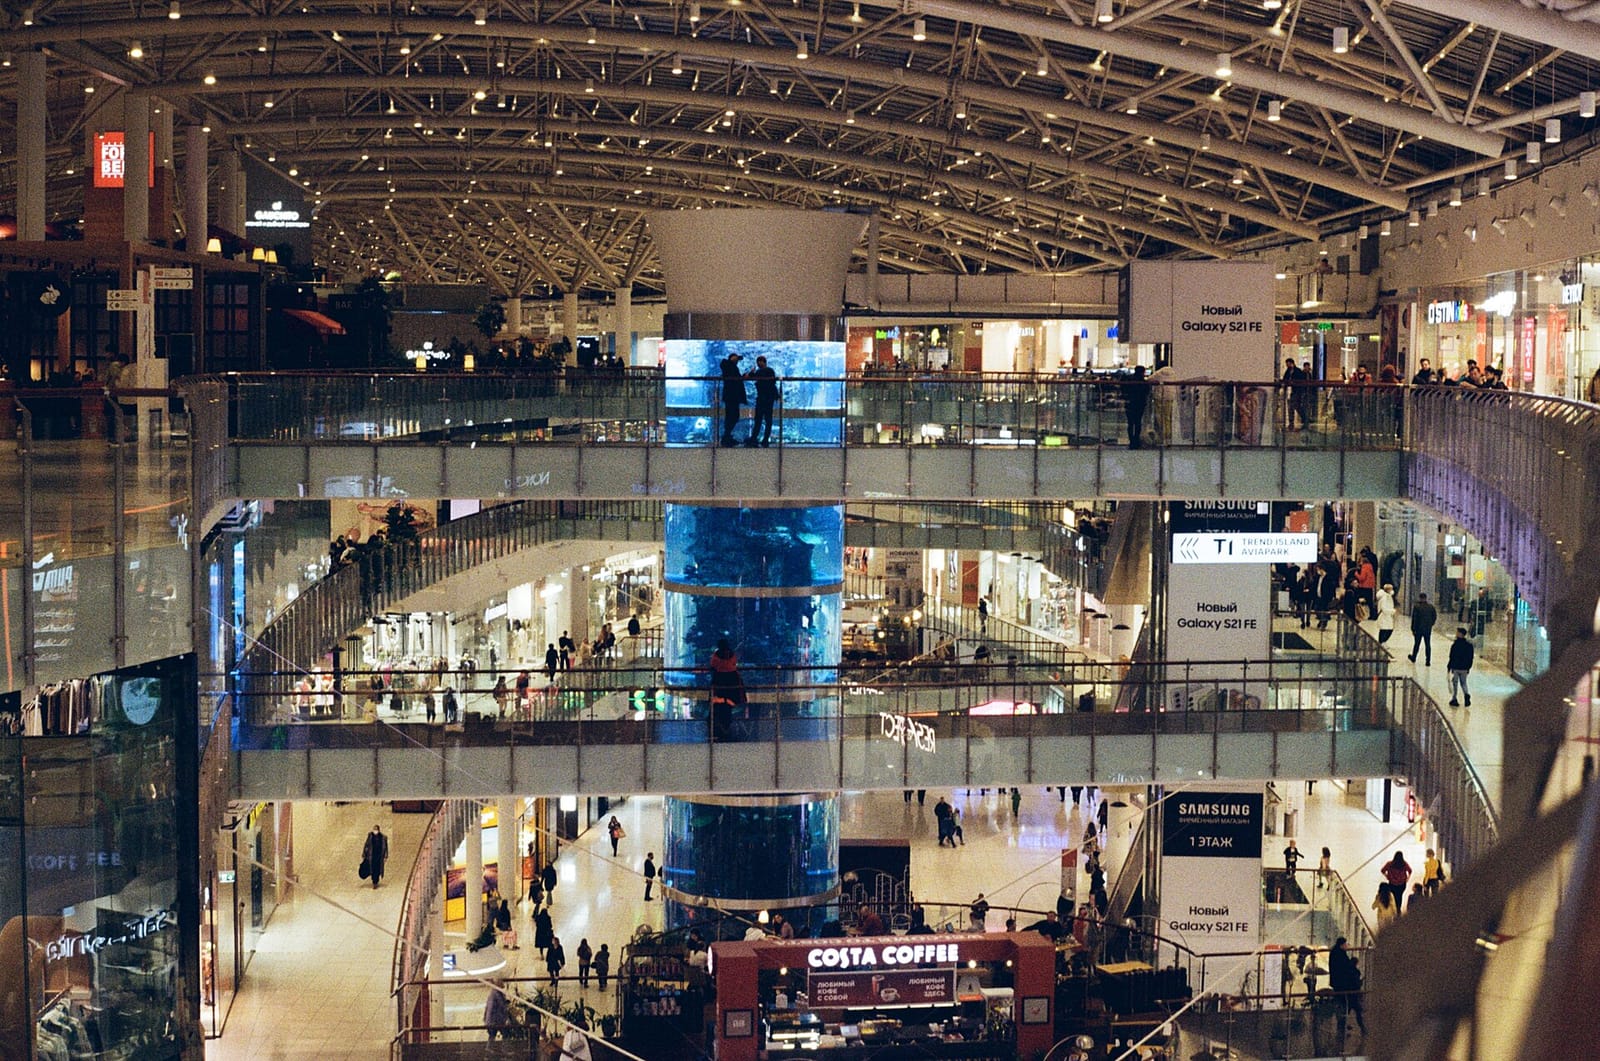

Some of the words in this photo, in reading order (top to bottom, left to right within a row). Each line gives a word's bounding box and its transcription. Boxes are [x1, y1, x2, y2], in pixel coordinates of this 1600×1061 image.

[1201, 305, 1243, 316] Новый
[1182, 321, 1227, 333] Galaxy
[1229, 322, 1247, 332] S21
[1249, 322, 1262, 332] FE
[1184, 500, 1257, 509] SAMSUNG
[1242, 538, 1273, 546] TREND
[1276, 538, 1310, 546] ISLAND
[1197, 602, 1237, 613] Новый
[1177, 618, 1221, 631] Galaxy
[1224, 619, 1242, 629] S21
[1244, 619, 1257, 629] FE
[1179, 803, 1250, 816] SAMSUNG
[1189, 836, 1195, 847] 1
[1199, 837, 1233, 848] ЭТАЖ
[1189, 906, 1229, 916] Новый
[1169, 921, 1213, 933] Galaxy
[1215, 922, 1233, 931] S21
[1235, 923, 1248, 932] FE
[808, 947, 877, 968] COSTA
[882, 944, 959, 963] COFFEE
